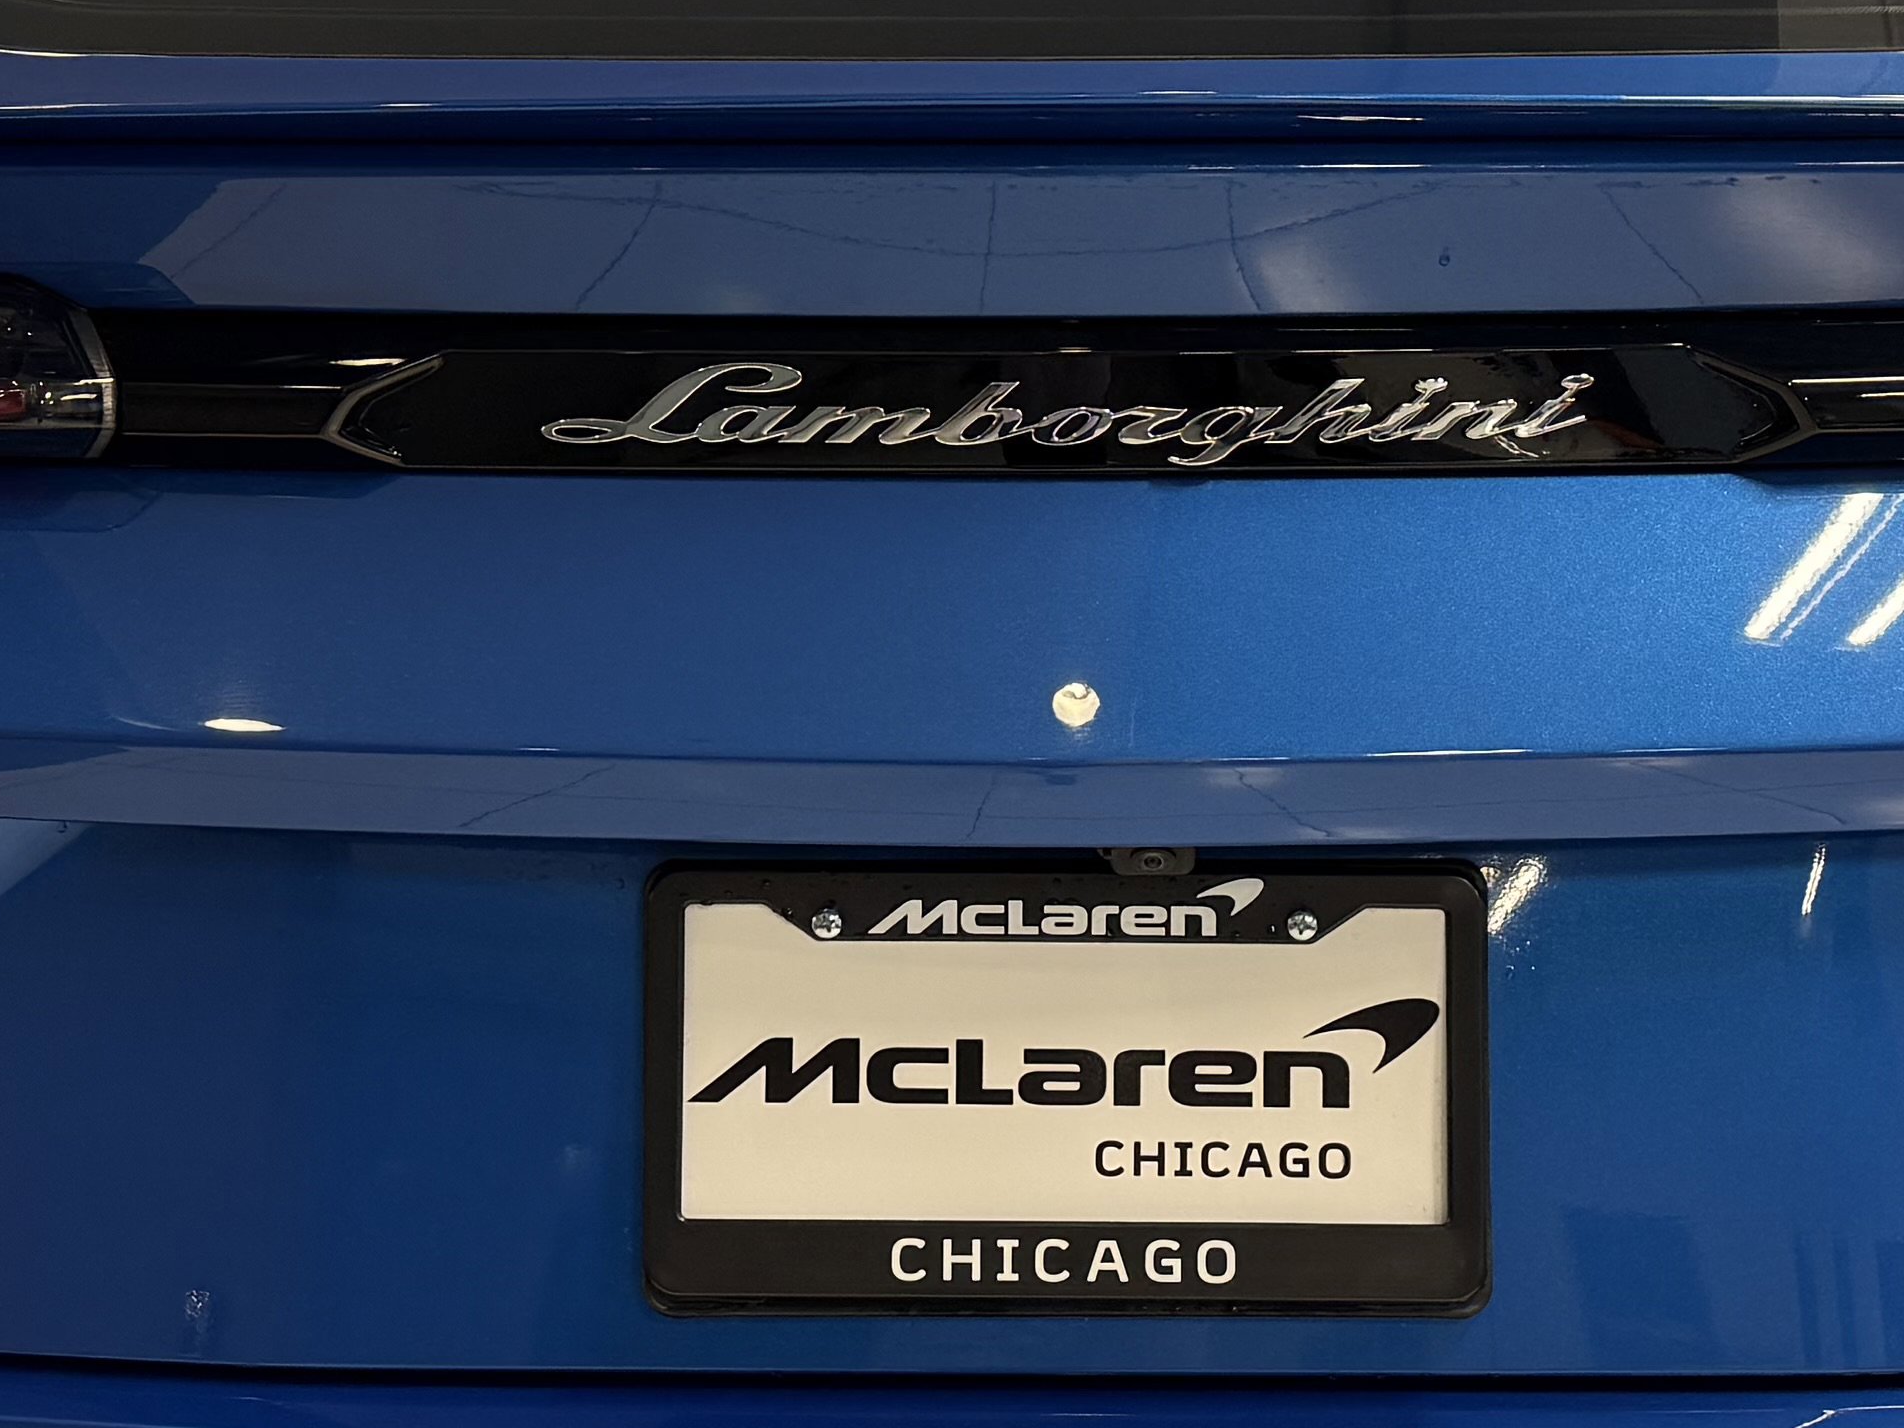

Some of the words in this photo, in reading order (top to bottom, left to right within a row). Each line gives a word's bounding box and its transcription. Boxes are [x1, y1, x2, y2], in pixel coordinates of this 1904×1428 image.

[540, 361, 1596, 468] Lamborghini
[867, 898, 1218, 938] McLaren
[687, 1036, 1351, 1109] McLaren
[1094, 1139, 1353, 1180] CHICAGO
[890, 1237, 1238, 1285] CHICAGO
